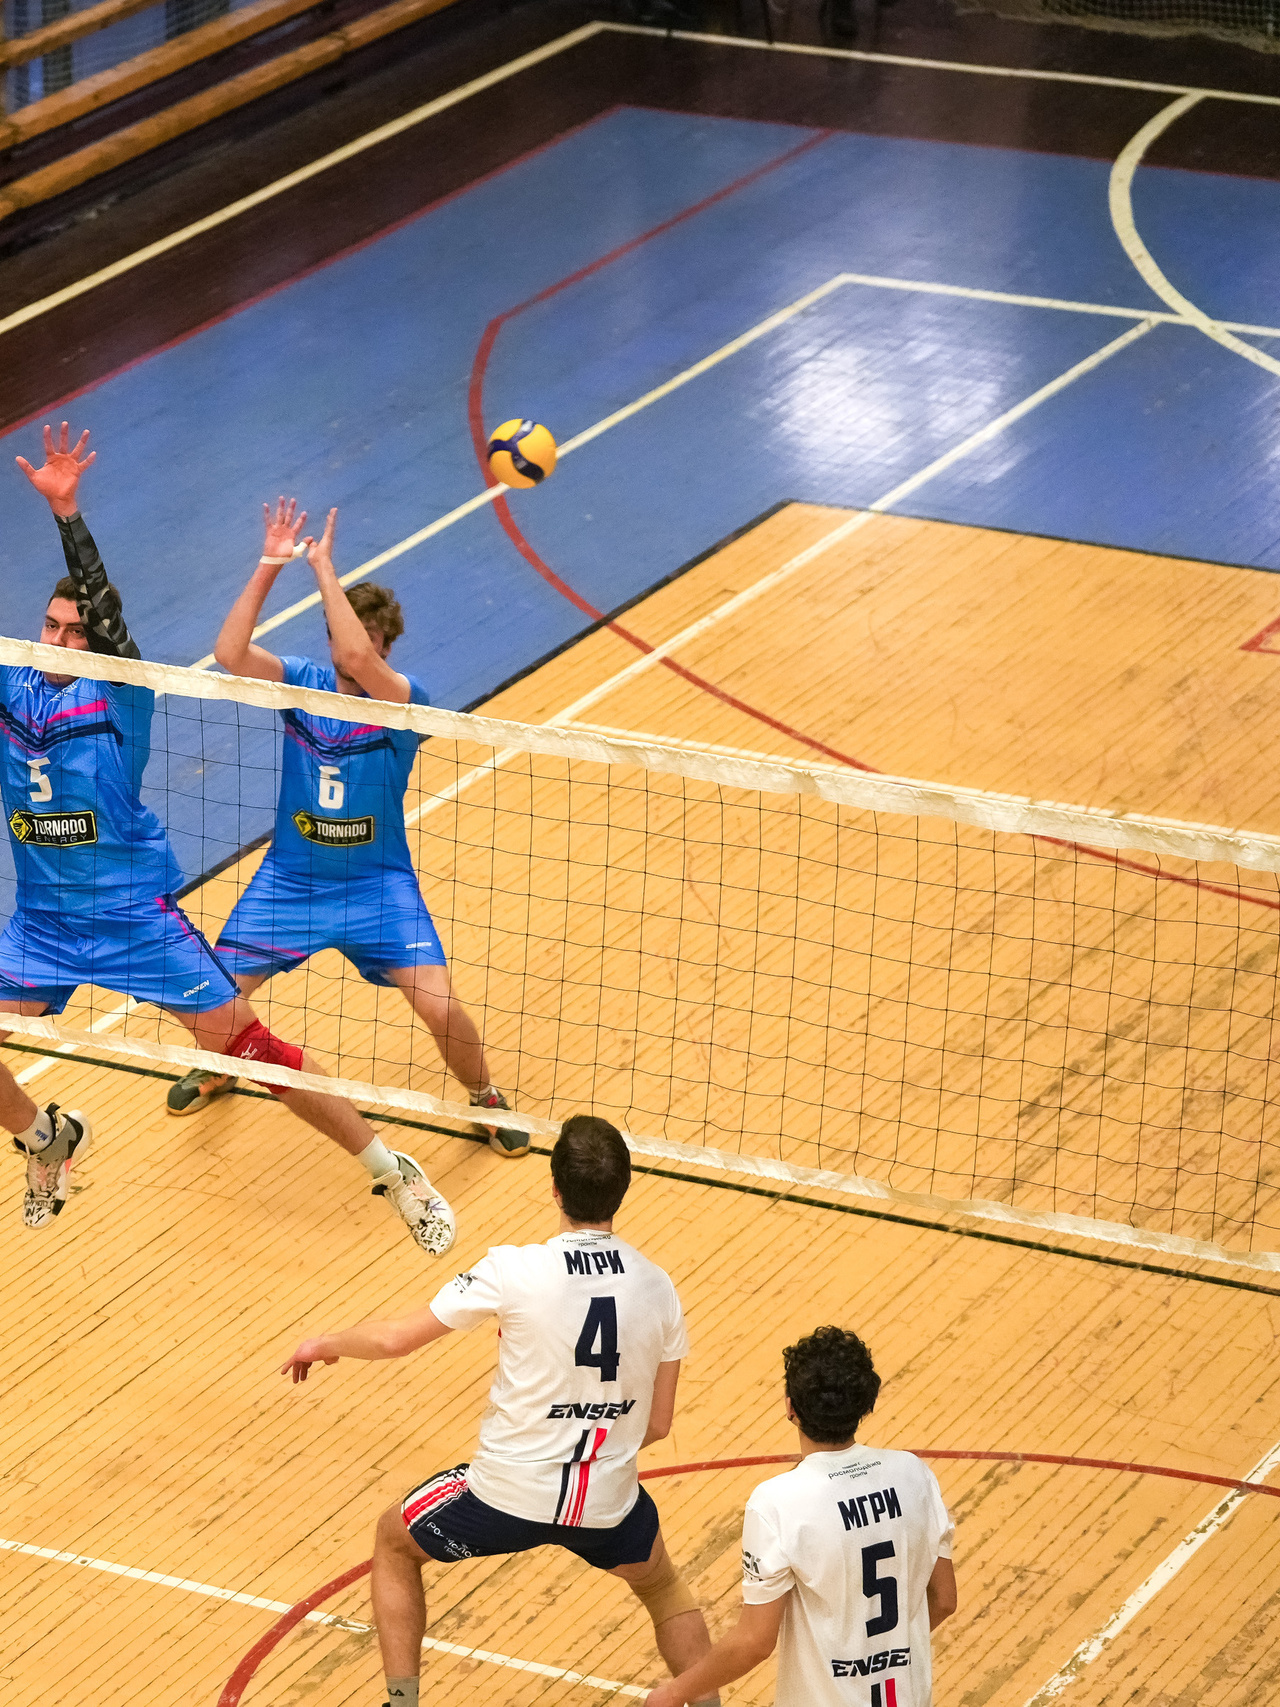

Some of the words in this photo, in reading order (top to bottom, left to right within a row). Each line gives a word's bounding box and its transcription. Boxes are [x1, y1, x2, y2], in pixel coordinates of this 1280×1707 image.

[26, 756, 52, 802] 5
[318, 765, 345, 809] 6
[32, 818, 87, 836] TORNADO
[315, 821, 367, 838] TORNADO
[563, 1250, 625, 1275] МГРИ
[575, 1296, 621, 1382] 4
[546, 1400, 637, 1420] ENSEN
[837, 1487, 902, 1531] МГРИ
[861, 1540, 899, 1638] 5
[831, 1647, 911, 1677] ENSE
